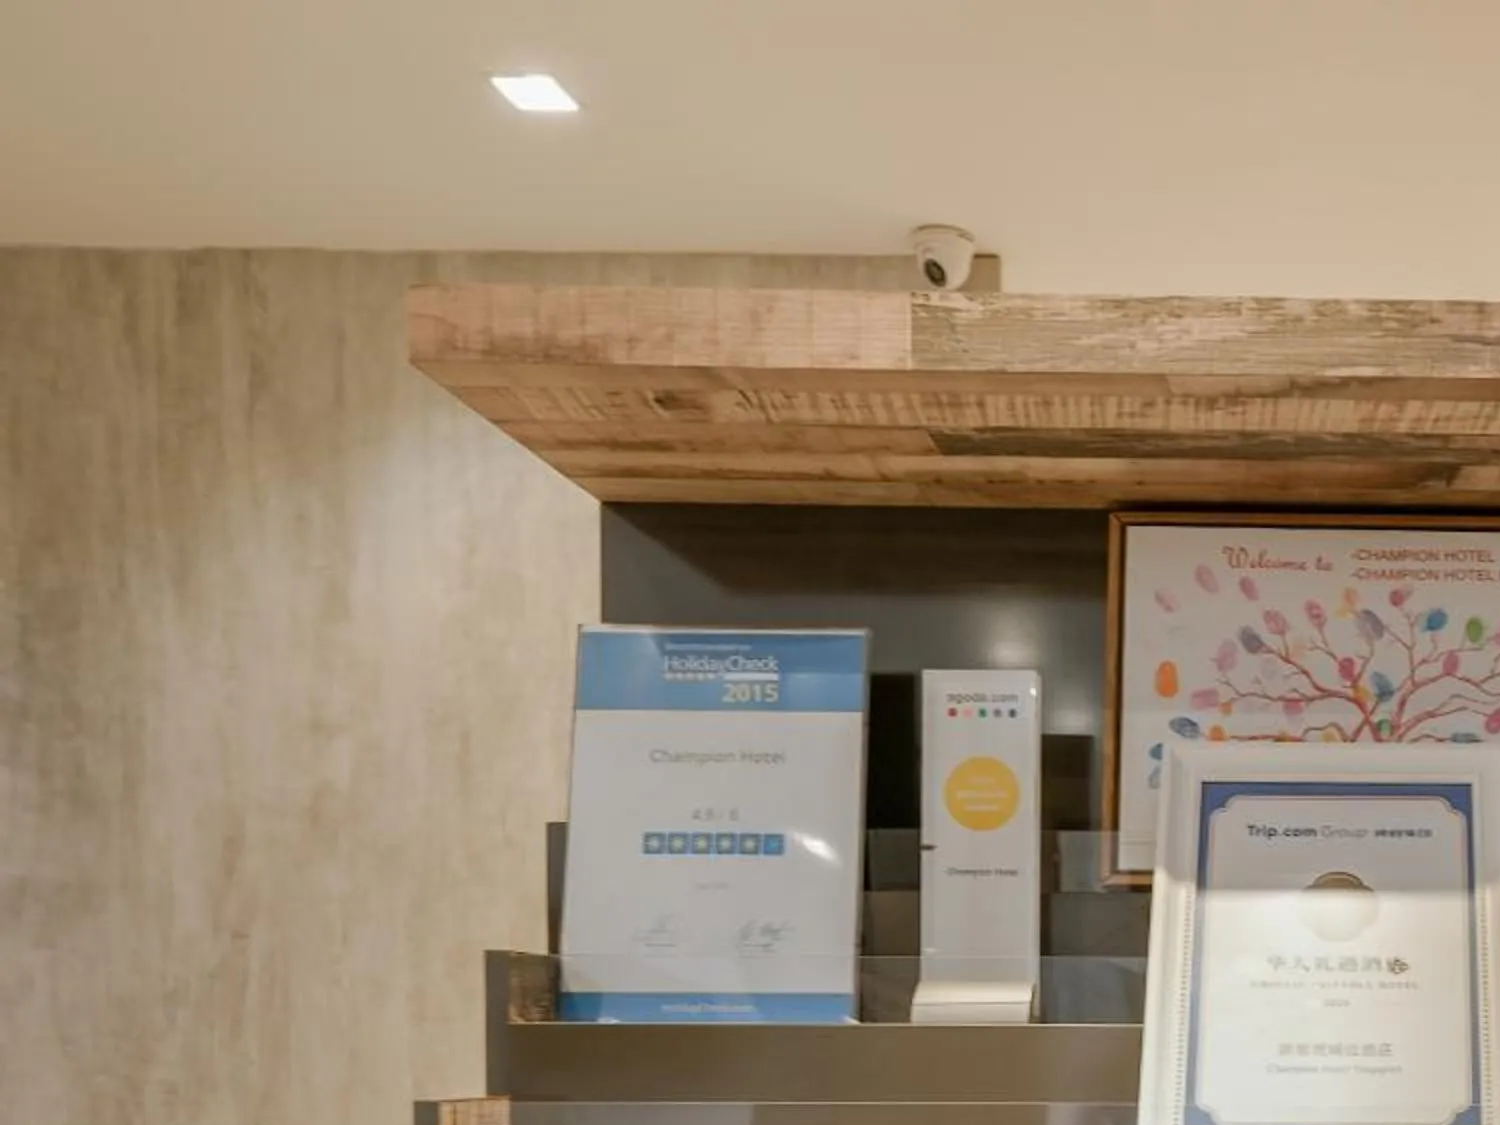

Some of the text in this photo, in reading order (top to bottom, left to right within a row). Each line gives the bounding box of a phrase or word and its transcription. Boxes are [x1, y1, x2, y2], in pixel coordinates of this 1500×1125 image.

[1221, 546, 1334, 571] Welcome to
[1444, 549, 1496, 563] HOTEL
[1444, 568, 1496, 582] HOTEL
[721, 683, 779, 703] 2015
[1247, 824, 1318, 840] Trip.com
